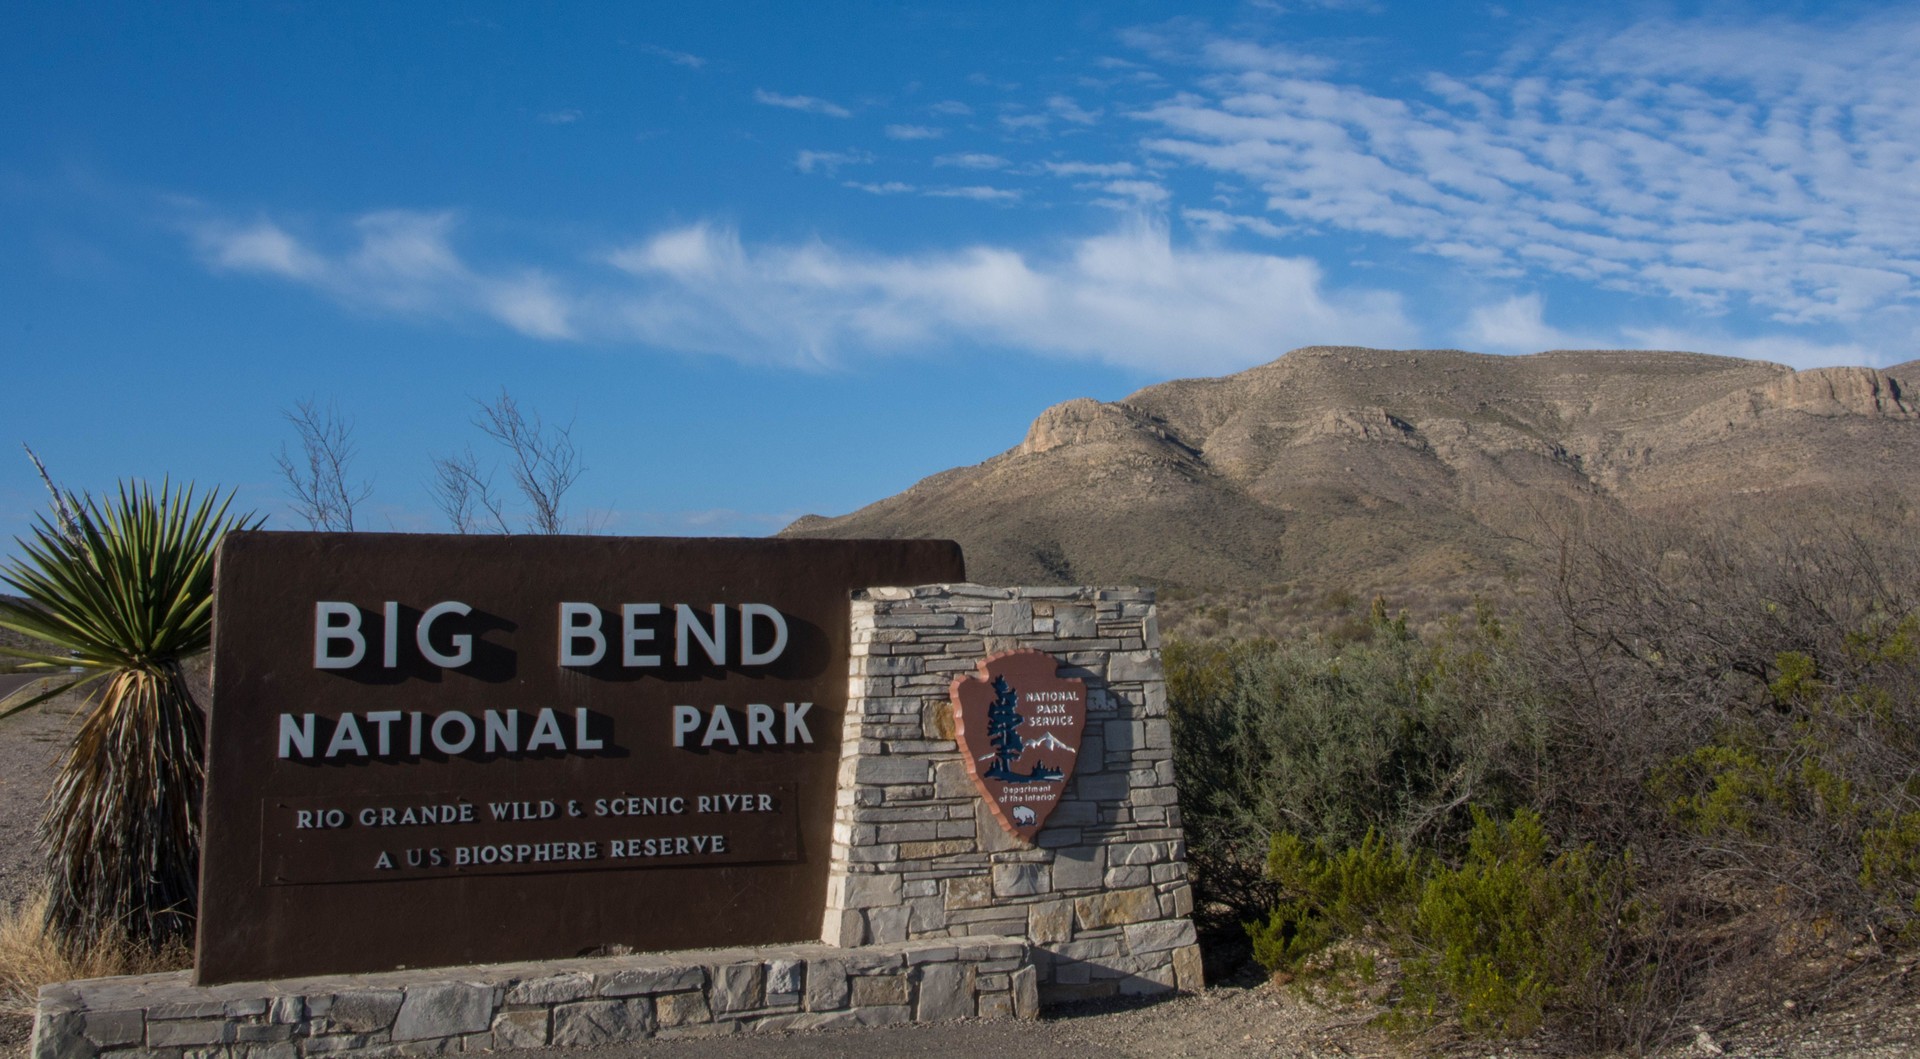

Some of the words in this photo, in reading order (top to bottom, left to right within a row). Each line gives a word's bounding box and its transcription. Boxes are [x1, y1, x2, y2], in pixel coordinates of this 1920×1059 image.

[314, 601, 472, 667] BIG
[559, 602, 788, 667] BEND
[1026, 691, 1079, 702] NATIONAL
[1037, 703, 1066, 714] PARK
[1029, 715, 1074, 726] SERVICE
[278, 708, 603, 758] NATIONAL
[673, 702, 814, 747] PARK
[1003, 785, 1051, 794] Department
[999, 795, 1008, 803] of
[1010, 794, 1023, 802] the
[1025, 793, 1056, 802] Interior
[297, 809, 344, 829] RIO
[359, 804, 473, 826] GRANDE
[489, 801, 555, 820] WILD
[568, 800, 581, 817] &
[594, 797, 684, 816] SCENIC
[697, 793, 773, 812] RIVER
[374, 851, 392, 869] A
[455, 842, 598, 865] BIOSPHERE
[611, 835, 726, 857] RESERVE
